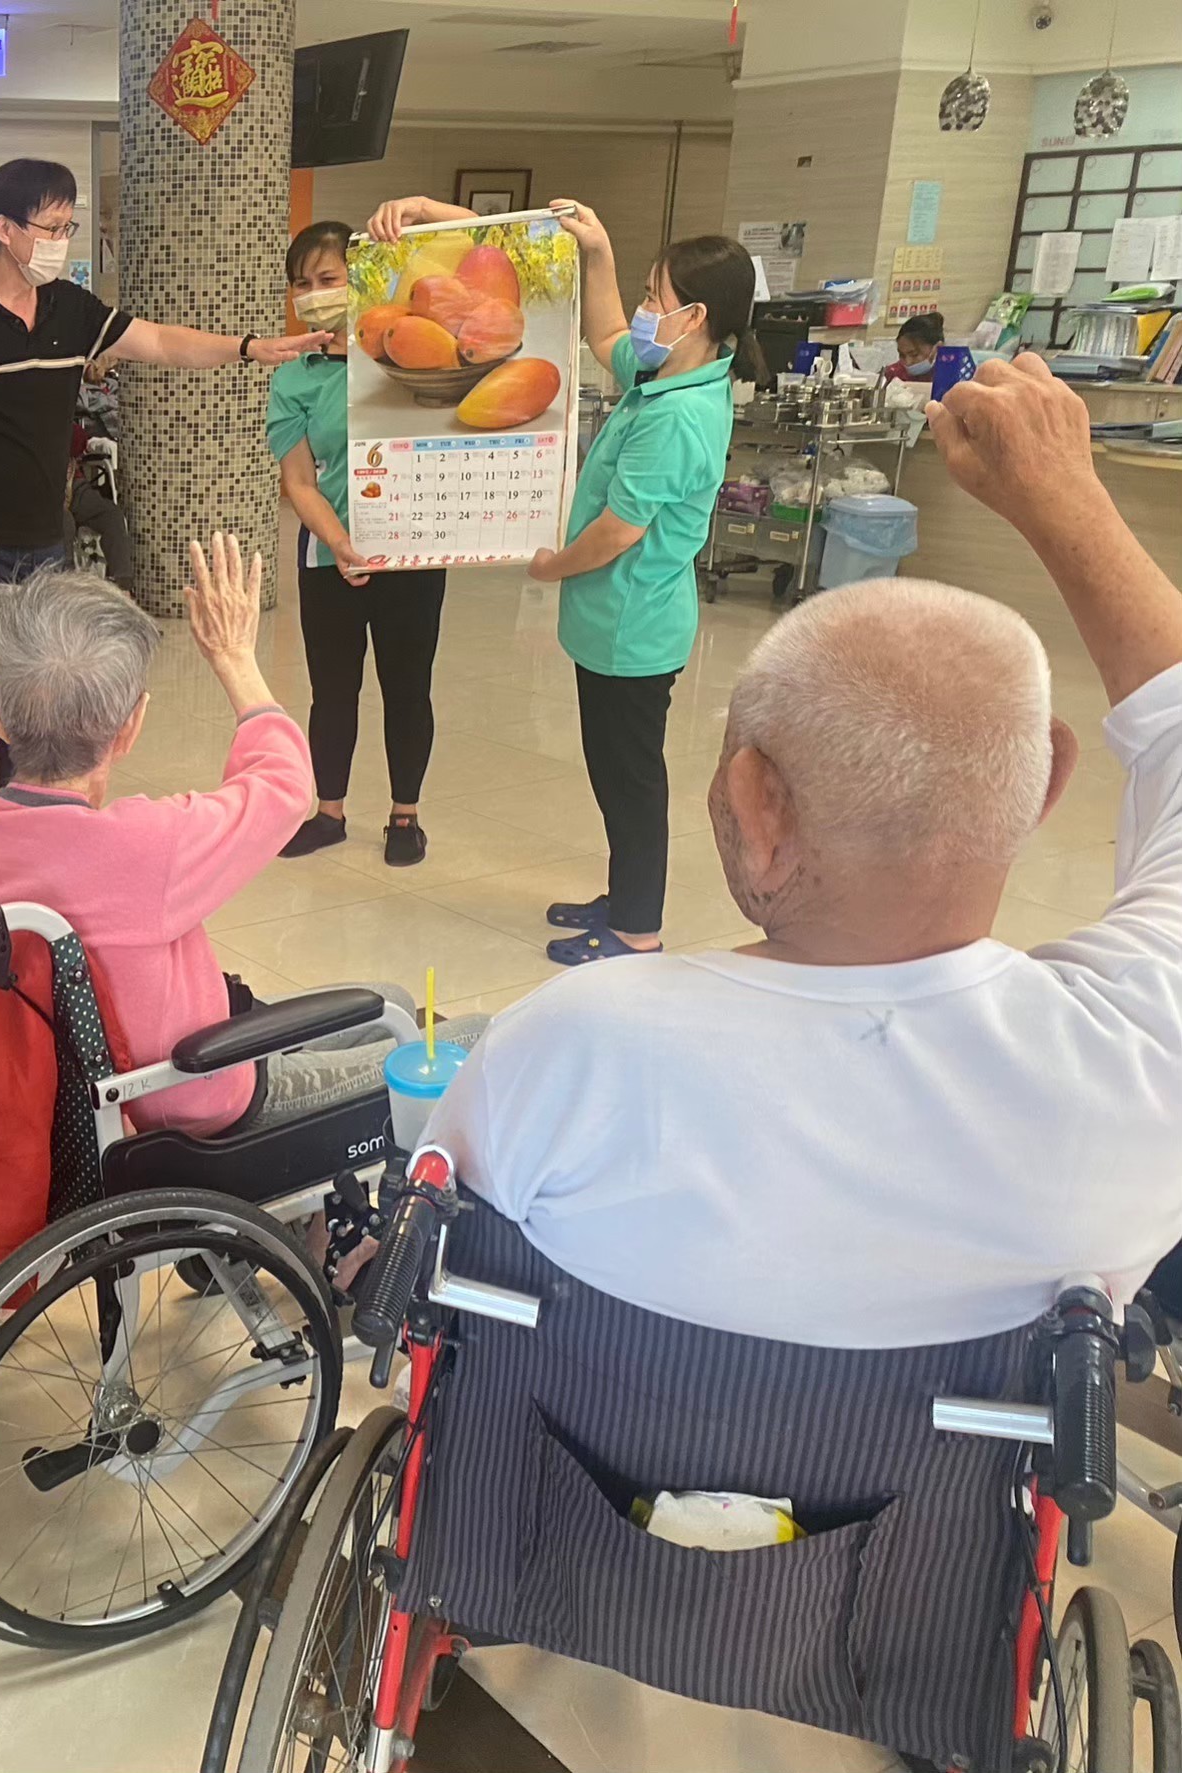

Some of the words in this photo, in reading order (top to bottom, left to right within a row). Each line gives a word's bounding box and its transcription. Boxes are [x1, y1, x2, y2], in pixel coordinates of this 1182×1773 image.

[367, 441, 383, 467] 6
[461, 472, 471, 480] 10
[486, 472, 495, 480] 11
[509, 471, 520, 479] 12
[533, 470, 543, 478] 13
[389, 494, 399, 502] 14
[414, 493, 423, 501] 15
[437, 492, 447, 501] 16
[461, 492, 470, 500] 17
[484, 491, 495, 500] 18
[508, 491, 518, 499] 19
[531, 490, 542, 499] 20
[389, 513, 398, 521] 21
[412, 512, 423, 520] 22
[436, 512, 446, 520] 23
[459, 511, 470, 519] 24
[483, 511, 494, 519] 25
[507, 511, 518, 519] 26
[530, 510, 540, 518] 27
[388, 531, 399, 539] 28
[411, 531, 422, 539] 29
[434, 531, 446, 539] 30
